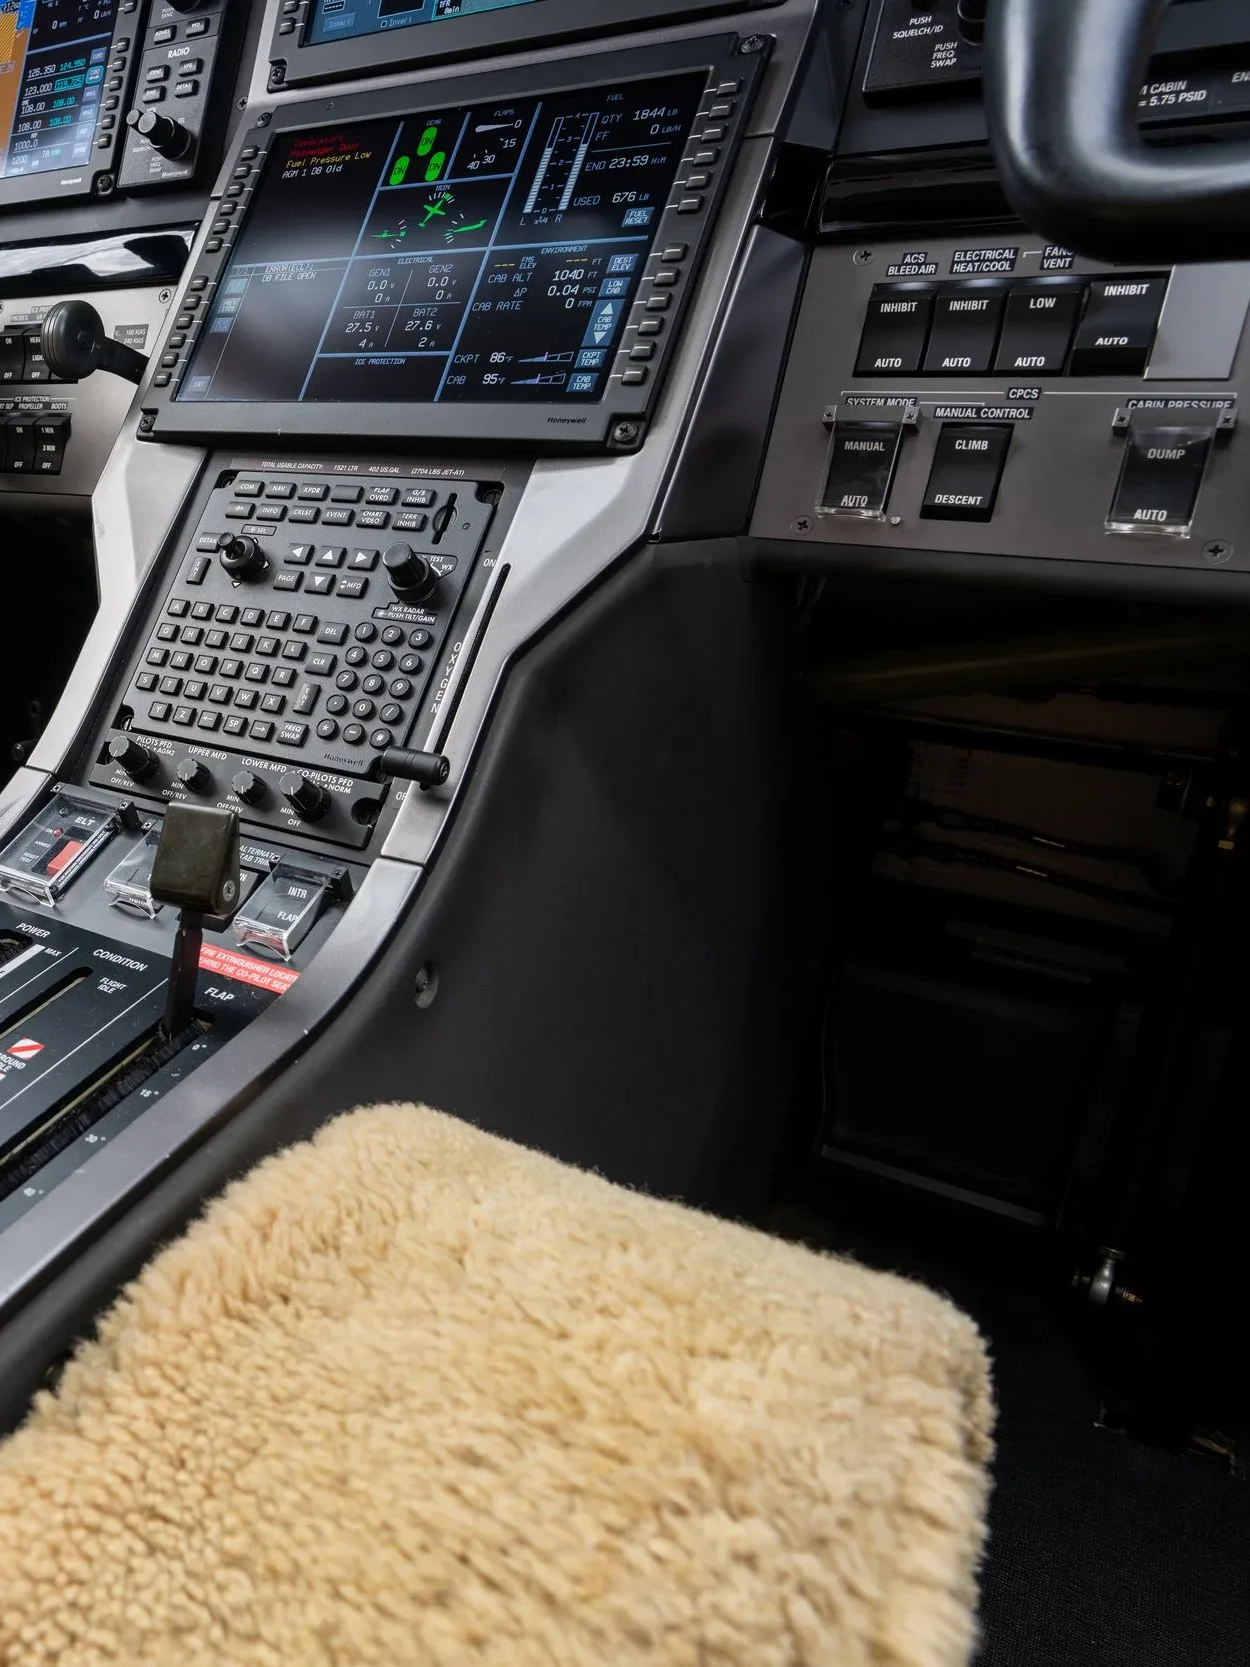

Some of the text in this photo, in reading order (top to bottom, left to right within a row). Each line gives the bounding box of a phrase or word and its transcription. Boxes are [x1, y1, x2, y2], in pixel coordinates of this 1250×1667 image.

[910, 16, 932, 25] PUSH
[893, 25, 943, 39] SQUELCH/ID
[935, 42, 957, 51] PUSH
[168, 47, 189, 58] RADIO
[933, 51, 954, 59] FREQ
[931, 58, 956, 68] SWAP
[28, 64, 56, 78] 126.350
[24, 83, 52, 96] 123.000
[1150, 80, 1187, 94] CABIN
[1149, 90, 1207, 106] 5.75 PSID
[22, 102, 45, 114] 108.00
[601, 107, 666, 124] QTY 1844
[18, 120, 41, 132] 108.00
[14, 139, 38, 150] 1000.0
[502, 139, 516, 148] 15
[286, 151, 371, 168] Fuel Pressure Low
[482, 154, 495, 164] 30
[585, 155, 649, 172] END 23:59
[467, 160, 480, 170] 40
[282, 169, 298, 179] AGM
[573, 191, 636, 206] USED 676
[625, 216, 649, 224] RESET
[541, 245, 587, 254] ENVIRONMENT
[398, 256, 434, 264] ELECTRICAL
[904, 254, 925, 263] ACS
[954, 249, 1016, 261] ELECTRICAL
[953, 260, 1011, 272] HEAT/COOL
[1043, 258, 1071, 268] VENT
[888, 264, 936, 275] BLEED AIR
[488, 269, 585, 283] CAB ALT 1040
[367, 280, 387, 290] 0.0
[427, 277, 448, 287] 0.0
[548, 285, 579, 296] 0.04
[1104, 284, 1149, 296] INHIBIT
[472, 301, 523, 311] CAB RATE
[880, 302, 917, 313] INHIBIT
[950, 300, 989, 311] INHIBIT
[1029, 298, 1056, 309] LOW
[353, 310, 375, 319] BAT1
[413, 308, 438, 317] BAT2
[346, 322, 372, 333] 27.5
[405, 320, 433, 331] 27.6
[1095, 337, 1128, 345] AUTO
[454, 354, 480, 364] CKPT
[874, 358, 902, 367] AUTO
[942, 358, 971, 367] AUTO
[1014, 357, 1045, 367] AUTO
[447, 376, 466, 385] CAB
[1009, 389, 1039, 399] CPCS
[935, 408, 1031, 418] MANUAL CONTROL
[845, 441, 885, 451] MANUAL
[955, 440, 988, 450] CLIMB
[1147, 449, 1185, 459] DUMP
[841, 495, 868, 506] AUTO
[935, 495, 983, 505] DESCENT
[1133, 509, 1167, 521] AUTO
[404, 614, 435, 623] TILT/GAIN
[284, 724, 302, 732] FREQ
[281, 731, 300, 740] SWAP
[136, 736, 159, 746] PILOTS
[188, 747, 227, 760] UPPER MFD
[324, 753, 364, 767] Honeywell
[242, 758, 286, 773] LOWER MFD
[111, 778, 134, 787] OFF/REV
[338, 778, 353, 787] PFD
[329, 784, 351, 794] NORM
[162, 790, 187, 800] OFF/REV
[280, 807, 295, 815] MIN
[75, 816, 95, 827] ELT
[288, 819, 301, 827] OFF
[288, 887, 307, 899] INTR
[277, 911, 298, 923] FLAP
[16, 922, 50, 938] POWER
[44, 948, 62, 957] MAX
[92, 949, 148, 972] CONDITION
[200, 947, 216, 956] FIRE
[216, 950, 268, 973] EXTINGUISHER
[221, 964, 270, 984] THE CO-PILOT
[100, 977, 127, 990] FLIGHT
[204, 987, 234, 1000] FLAP
